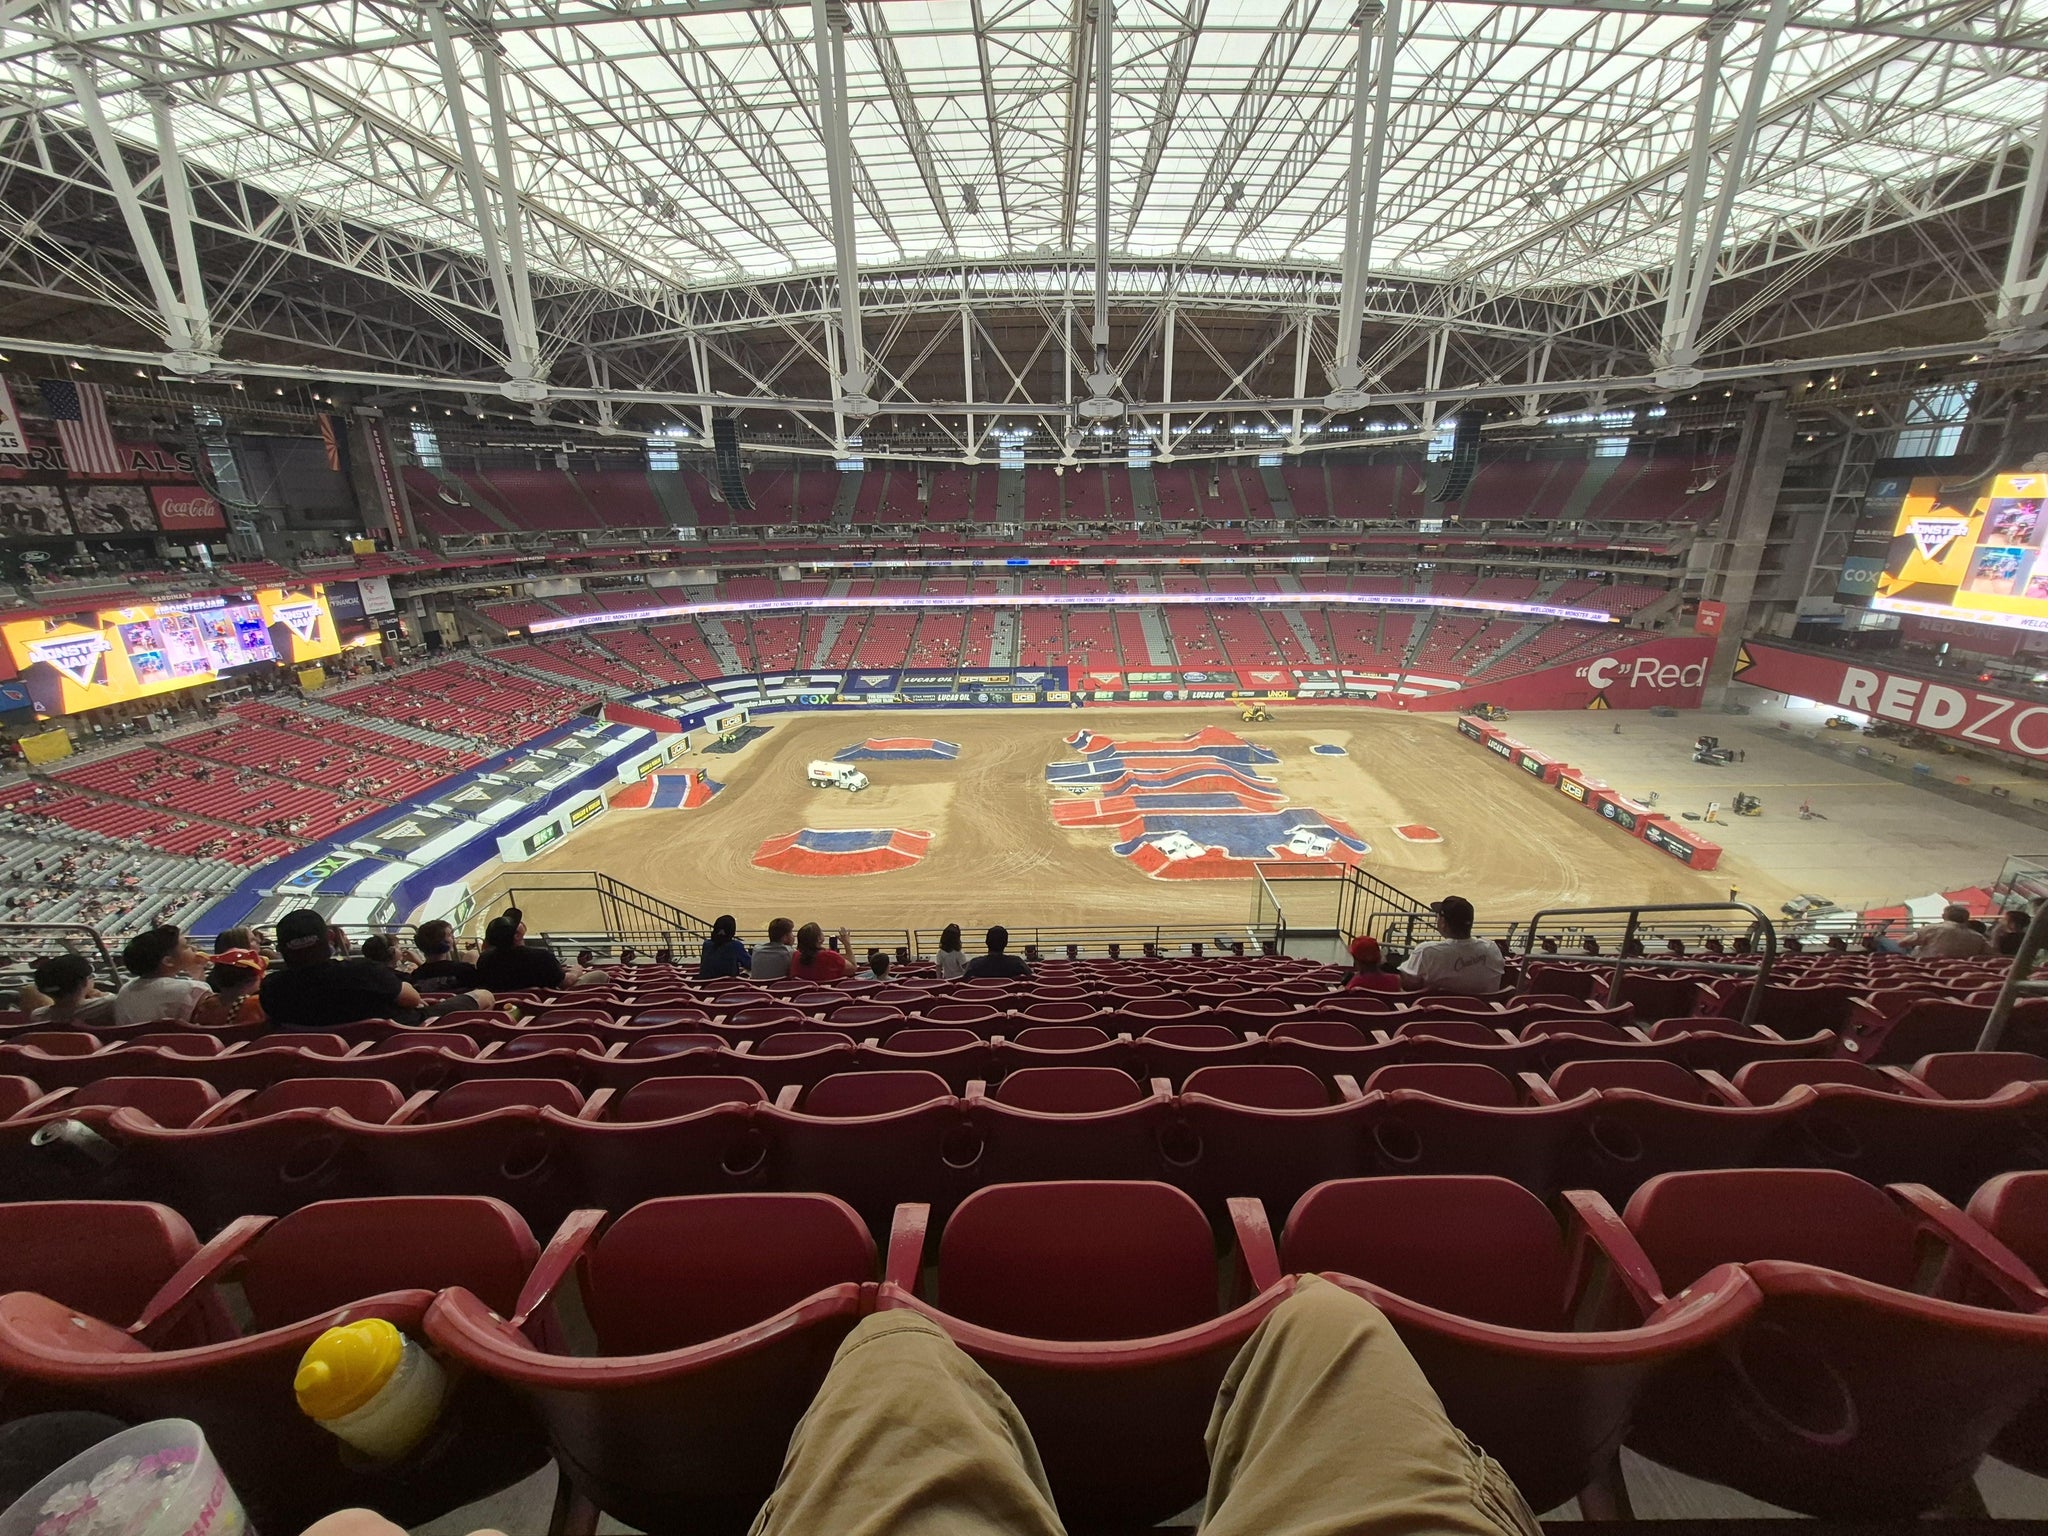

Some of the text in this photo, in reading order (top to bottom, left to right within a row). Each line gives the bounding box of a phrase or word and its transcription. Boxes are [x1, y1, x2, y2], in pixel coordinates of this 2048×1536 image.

[1905, 525, 1969, 537] MONSTER
[1844, 568, 1880, 583] COX
[151, 593, 192, 603] CARDINALS
[273, 607, 324, 621] MONSTER
[1918, 620, 2001, 642] REDZONE
[29, 639, 112, 663] MONSTER
[58, 653, 99, 669] JAM
[1630, 657, 1709, 688] Red
[800, 694, 830, 704] COX
[938, 694, 959, 702] LUCAS
[1487, 739, 1511, 758] LUCAS OIL
[1562, 781, 1584, 798] JCB
[533, 825, 555, 849] BKT
[289, 855, 343, 888] COX
